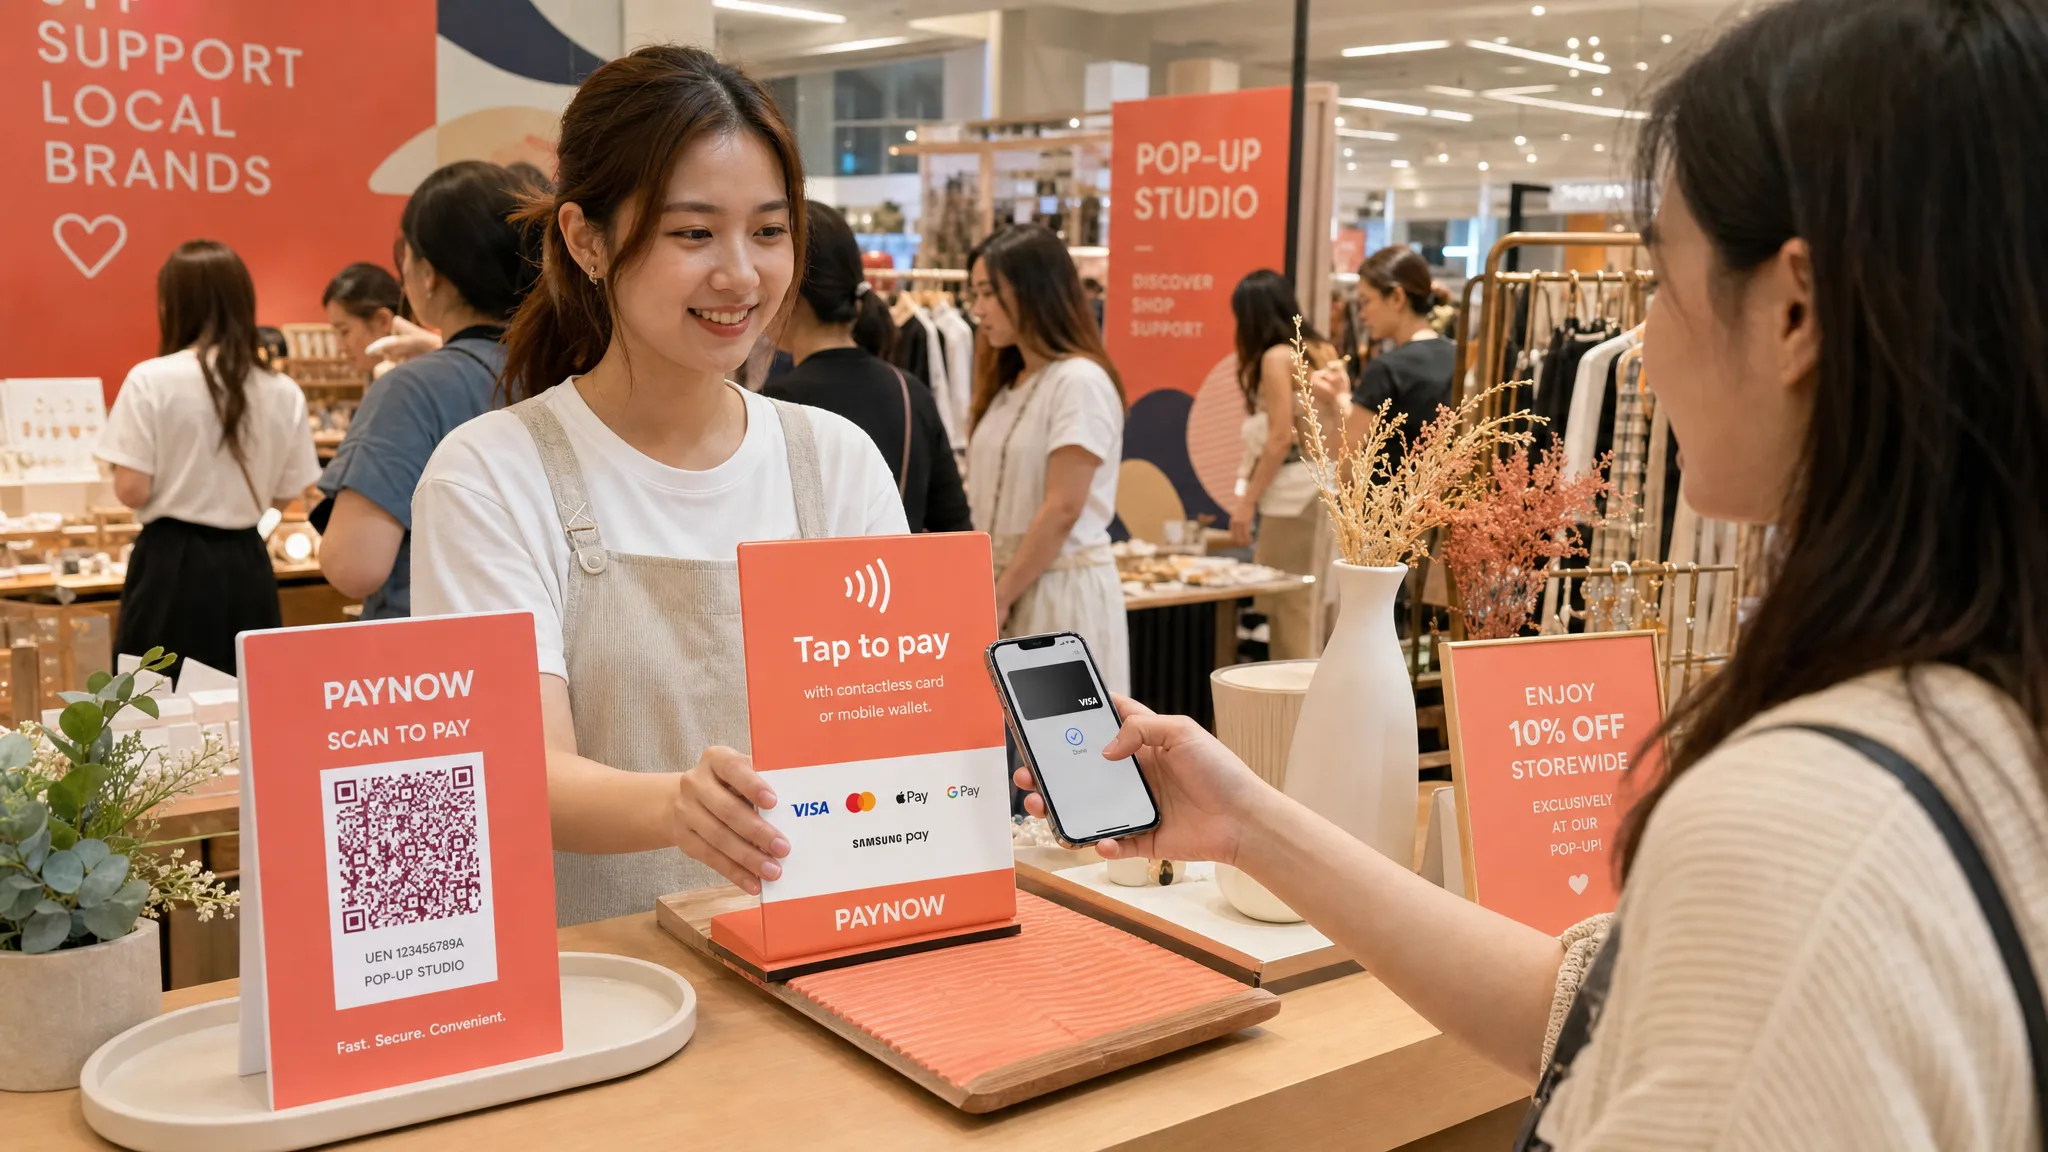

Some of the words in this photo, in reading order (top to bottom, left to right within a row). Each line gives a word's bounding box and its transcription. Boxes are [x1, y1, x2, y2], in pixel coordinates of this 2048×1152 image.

[38, 19, 303, 88] SUPPORT
[42, 80, 236, 138] LOCAL
[45, 140, 271, 196] BRANDS
[1136, 137, 1262, 176] POP-UP
[1134, 184, 1260, 221] STUDIO
[1132, 273, 1214, 291] DISCOVER
[1131, 296, 1175, 314] SHOP
[1130, 320, 1204, 338] SUPPORT
[793, 635, 851, 667] Tap
[858, 633, 890, 658] to
[898, 632, 950, 663] pay
[323, 669, 475, 710] PAYNOW
[804, 684, 833, 700] with
[836, 679, 913, 697] contactless
[915, 675, 944, 690] card
[1525, 682, 1595, 706] ENJOY
[819, 711, 833, 723] or
[838, 705, 885, 721] mobile
[888, 701, 932, 716] wallet.
[1078, 697, 1099, 707] VISA
[327, 727, 389, 751] SCAN
[395, 723, 427, 743] TO
[432, 718, 471, 740] PAY
[1508, 717, 1566, 747] 10%
[1572, 713, 1625, 742] OFF
[1511, 752, 1629, 780] STOREWIDE
[906, 791, 929, 805] Pay
[960, 785, 980, 799] Pay
[1533, 793, 1613, 814] EXCLUSIVELY
[791, 801, 830, 817] VISA
[1552, 820, 1567, 834] AT
[1571, 817, 1598, 832] OUR
[852, 834, 902, 849] SAMSUNG
[906, 830, 929, 844] pay
[1550, 838, 1602, 857] POP-UP!
[835, 894, 945, 931] PAYNOW
[365, 949, 393, 964] UEN
[396, 937, 465, 959] 123456789A
[365, 968, 413, 987] POP-UP
[417, 959, 465, 978] STUDIO
[337, 1038, 371, 1055] Fast.
[375, 1029, 426, 1047] Secure.
[429, 1011, 507, 1036] Convenient.
